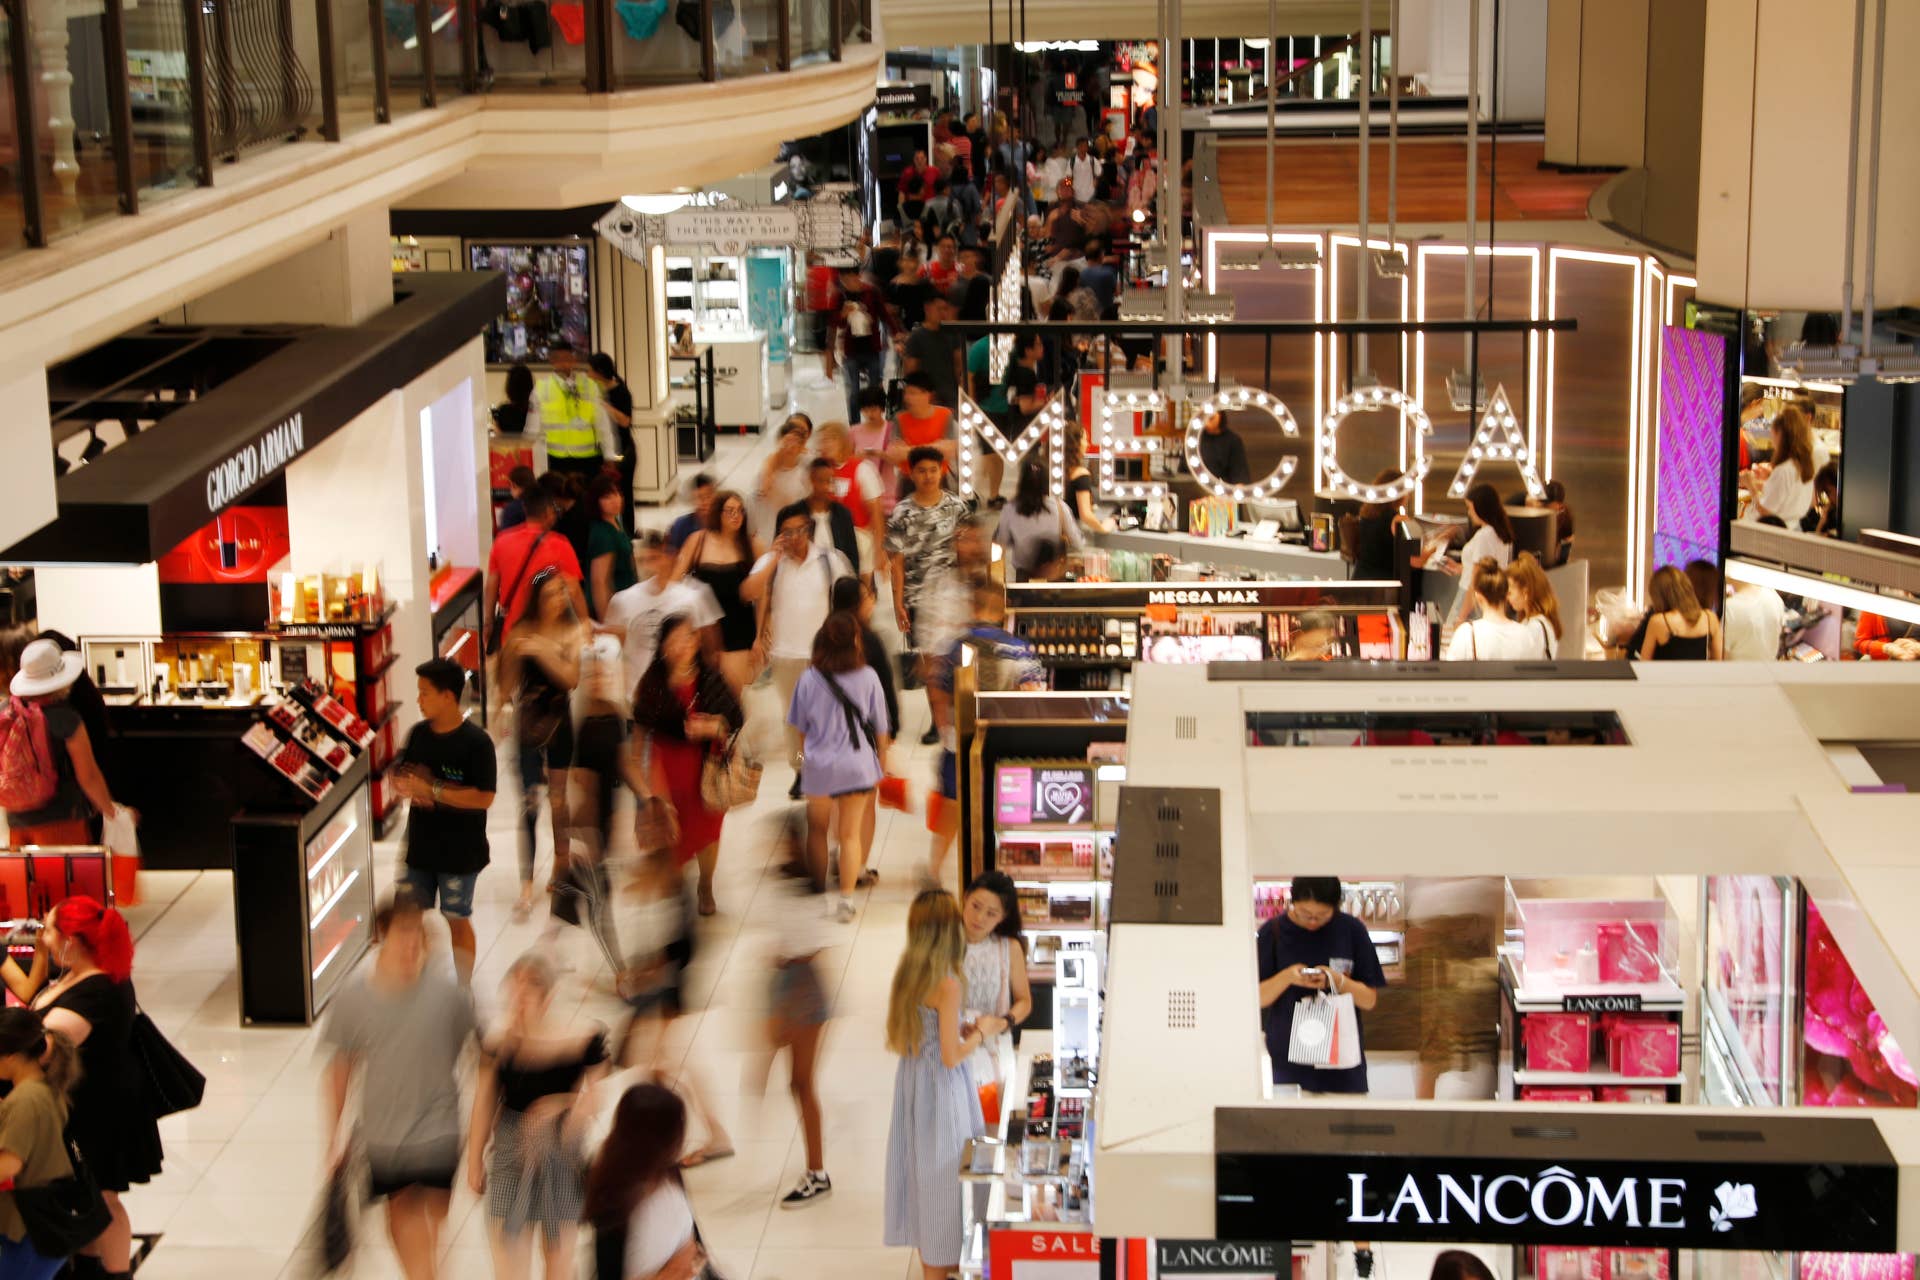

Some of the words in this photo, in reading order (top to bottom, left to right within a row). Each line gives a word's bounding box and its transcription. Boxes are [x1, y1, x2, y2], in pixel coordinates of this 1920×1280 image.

[677, 226, 698, 235] THE
[705, 226, 754, 235] ROCKET
[760, 226, 790, 235] SHIP
[692, 216, 720, 225] THIS
[726, 216, 750, 225] WAY
[757, 216, 772, 225] TO
[958, 384, 1546, 504] MECCA
[206, 444, 258, 512] GIORGIO
[259, 411, 304, 478] ARMANI
[1149, 590, 1215, 604] MECCA
[1217, 590, 1260, 604] MAX
[1566, 995, 1638, 1012] LANCÔME
[1347, 1164, 1686, 1229] LANCÔME
[1031, 1234, 1101, 1254] SALE
[1160, 1242, 1274, 1266] LANCÔME
